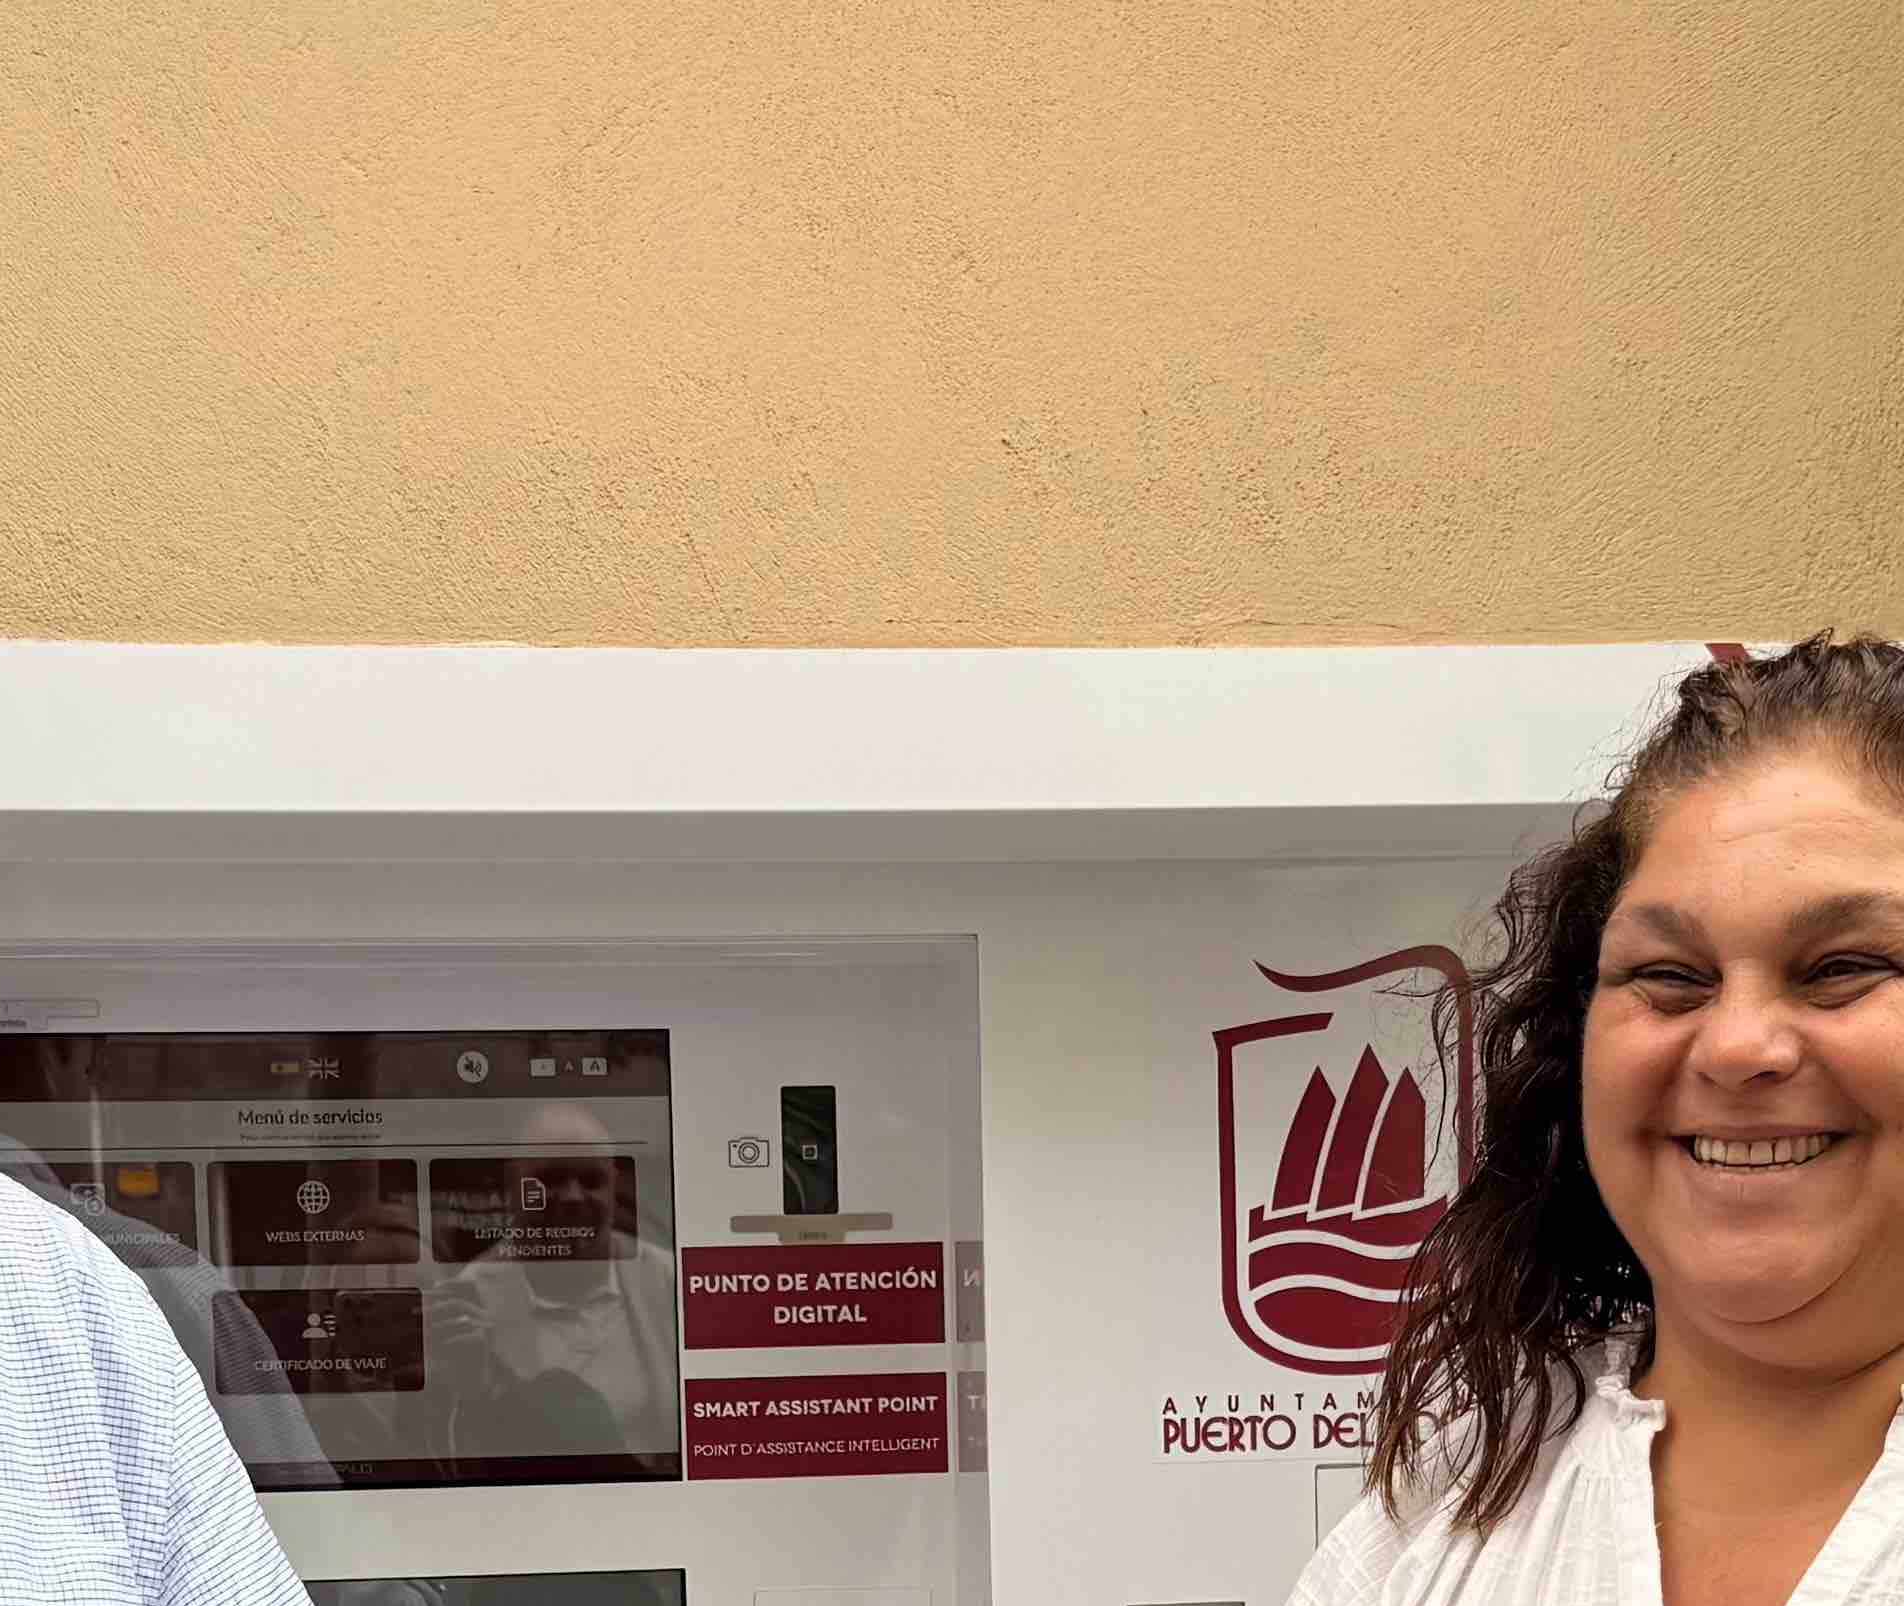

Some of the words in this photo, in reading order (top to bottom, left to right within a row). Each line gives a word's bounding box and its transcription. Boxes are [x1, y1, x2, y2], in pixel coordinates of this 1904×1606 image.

[238, 1107, 285, 1125] Menú
[288, 1108, 310, 1125] de
[311, 1107, 383, 1125] servicios
[264, 1231, 301, 1243] WEBS
[303, 1230, 366, 1242] EXTERNAS
[474, 1228, 525, 1239] LISTADO
[527, 1228, 545, 1239] DE
[688, 1274, 770, 1294] PUNTO
[776, 1273, 809, 1292] DE
[815, 1266, 937, 1291] ATENCIÓN
[773, 1304, 867, 1324] DIGITAL
[256, 1358, 333, 1372] CERTIFICADO
[335, 1358, 353, 1371] DE
[354, 1357, 388, 1369] VIAJE
[693, 1400, 761, 1418] SMART
[765, 1397, 873, 1417] ASSISTANT
[877, 1395, 939, 1413] POINT
[1162, 1391, 1375, 1415] AYUNTAM
[1162, 1413, 1297, 1454] PUERTO
[1312, 1411, 1375, 1449] DEL
[694, 1443, 738, 1456] POINT
[848, 1436, 940, 1453] INTELLIGENT
